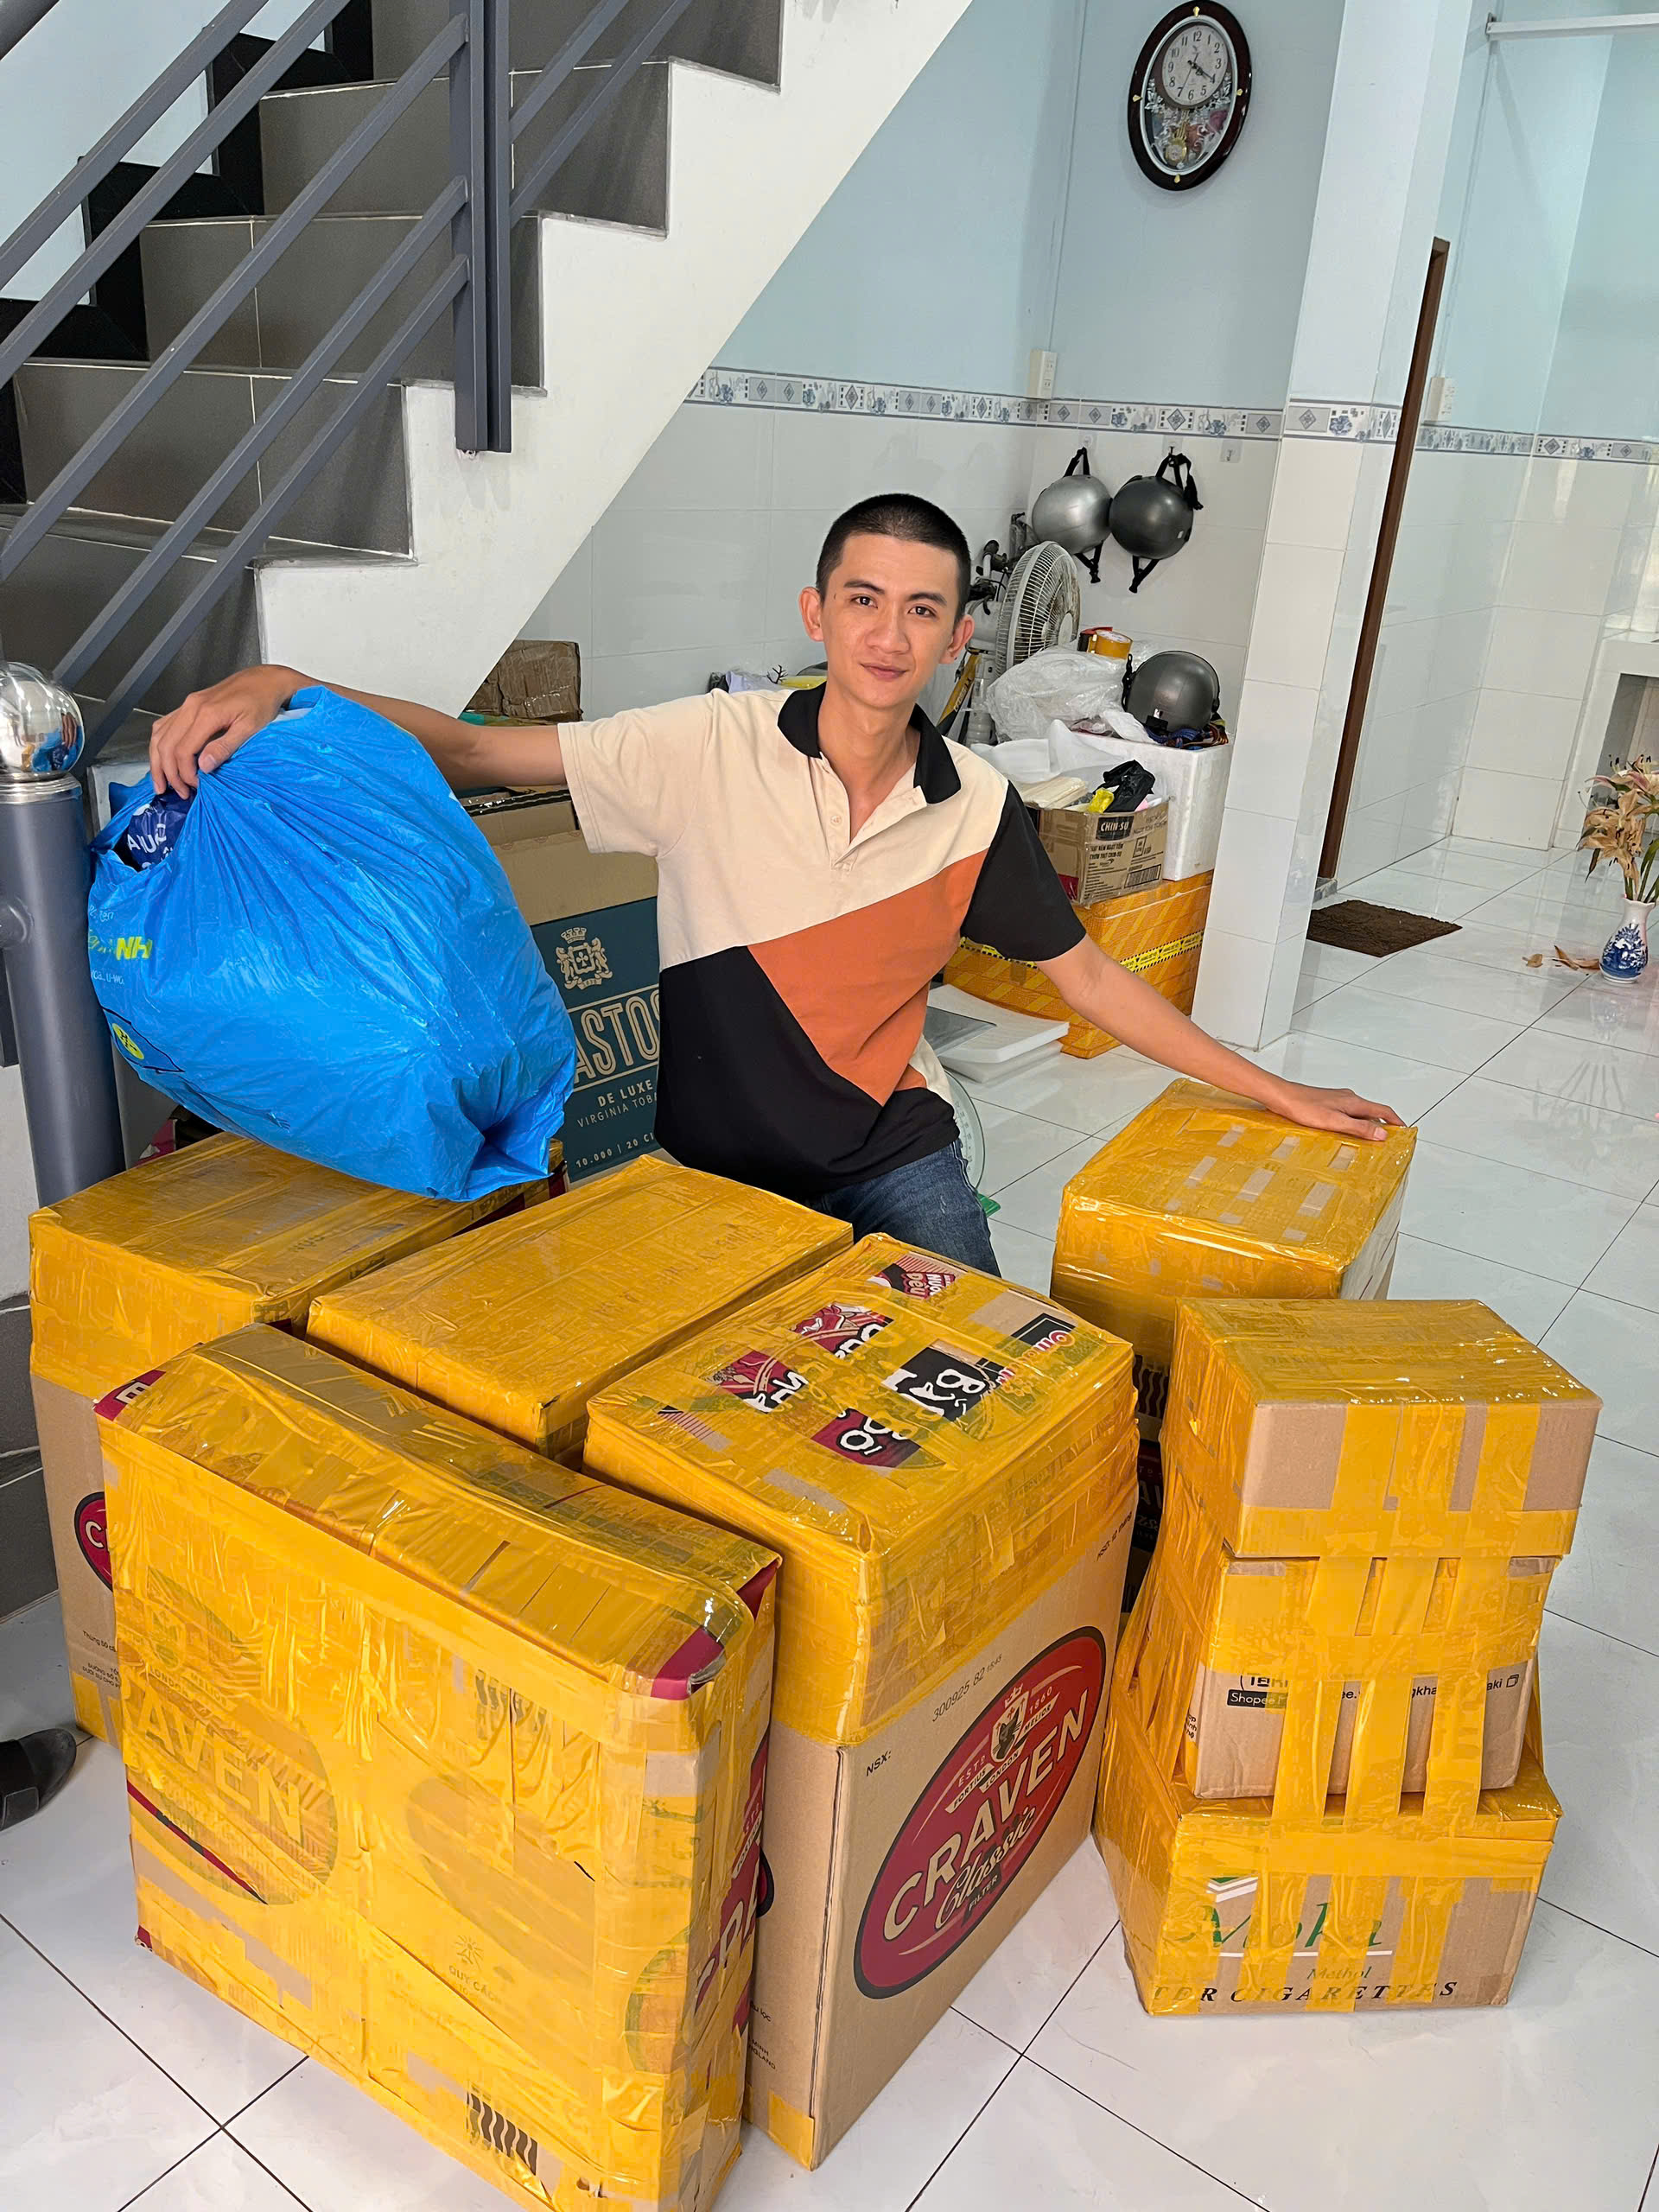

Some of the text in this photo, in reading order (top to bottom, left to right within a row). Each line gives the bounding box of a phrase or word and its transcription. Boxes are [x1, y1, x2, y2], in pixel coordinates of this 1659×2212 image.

[1182, 36, 1188, 46] 11
[1193, 30, 1202, 41] 12
[1214, 42, 1220, 53] 2
[1171, 48, 1179, 58] 10
[1215, 58, 1221, 69] 3
[1168, 62, 1173, 73] 9
[1169, 76, 1175, 87] 8
[1177, 86, 1183, 97] 7
[1200, 86, 1206, 96] 5
[1188, 89, 1194, 100] 6
[597, 1079, 653, 1108] DE LUXE
[576, 1103, 629, 1128] VIRGINIA
[575, 1148, 613, 1168] 10.000
[626, 1138, 639, 1150] 20
[932, 1680, 969, 1723] 300925
[972, 1667, 986, 1687] 82
[1029, 1686, 1052, 1714] 1860
[1230, 1692, 1275, 1707] Shopee
[1023, 1703, 1052, 1734] MELIOR
[866, 1750, 892, 1777] NSX:
[985, 1750, 1020, 1789] LONDON
[952, 1768, 987, 1808] FORTIUS
[883, 1689, 1089, 1942] CRAVEN
[935, 1807, 1036, 1929] Classic
[969, 1874, 998, 1911] FILTER
